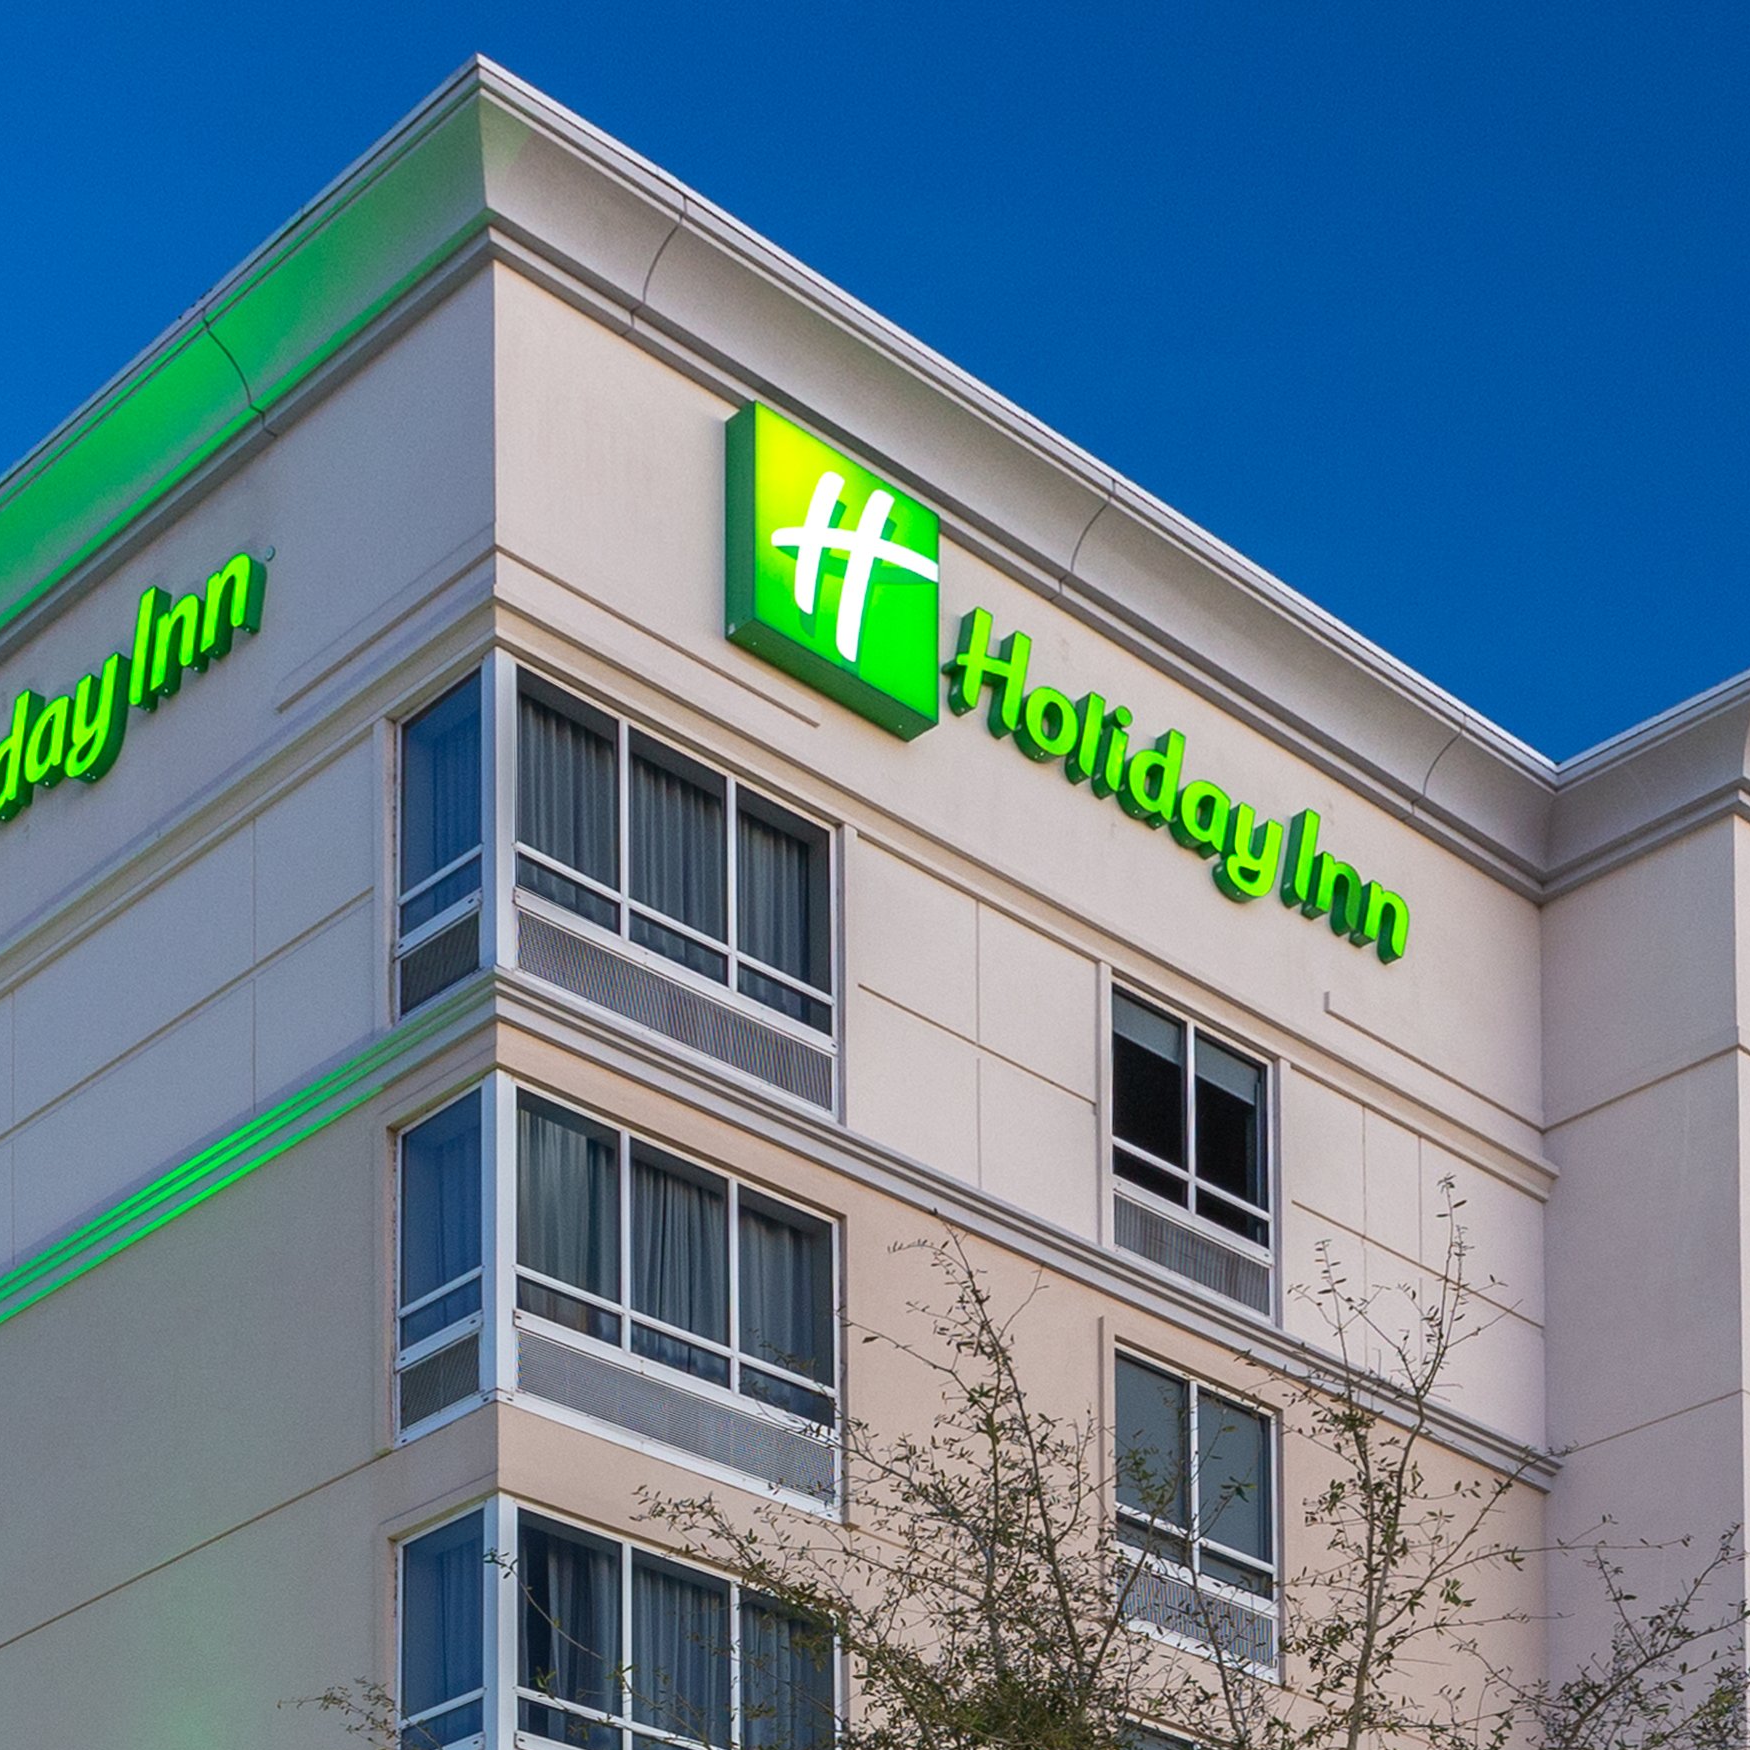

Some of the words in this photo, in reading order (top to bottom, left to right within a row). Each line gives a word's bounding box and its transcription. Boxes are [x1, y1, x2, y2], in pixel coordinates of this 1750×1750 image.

[129, 553, 258, 709] Inn
[950, 607, 1284, 900] Holiday
[1286, 809, 1410, 962] Inn
